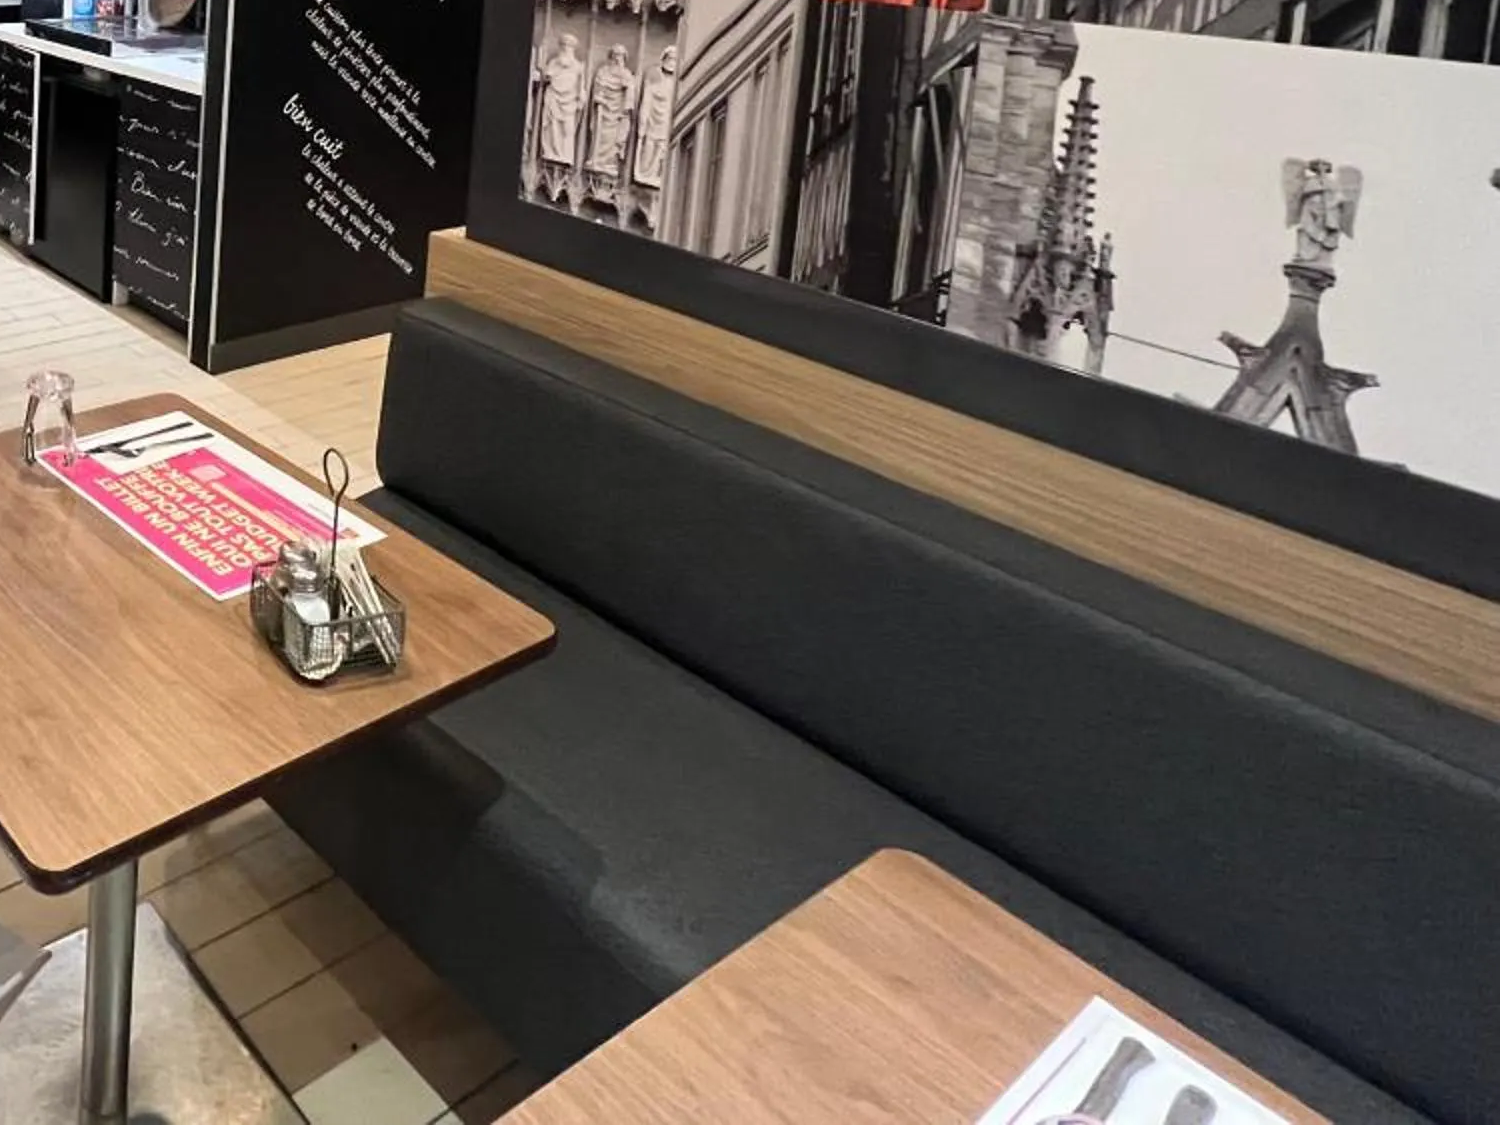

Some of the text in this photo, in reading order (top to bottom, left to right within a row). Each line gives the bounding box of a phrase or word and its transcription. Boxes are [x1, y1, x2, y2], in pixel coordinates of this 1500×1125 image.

[283, 93, 343, 160] bien cuit
[92, 477, 234, 576] ENFIN UN BILLET
[119, 475, 253, 567] QUI NE BOUFFE
[182, 501, 234, 536] TOUT
[229, 532, 274, 562] PAS
